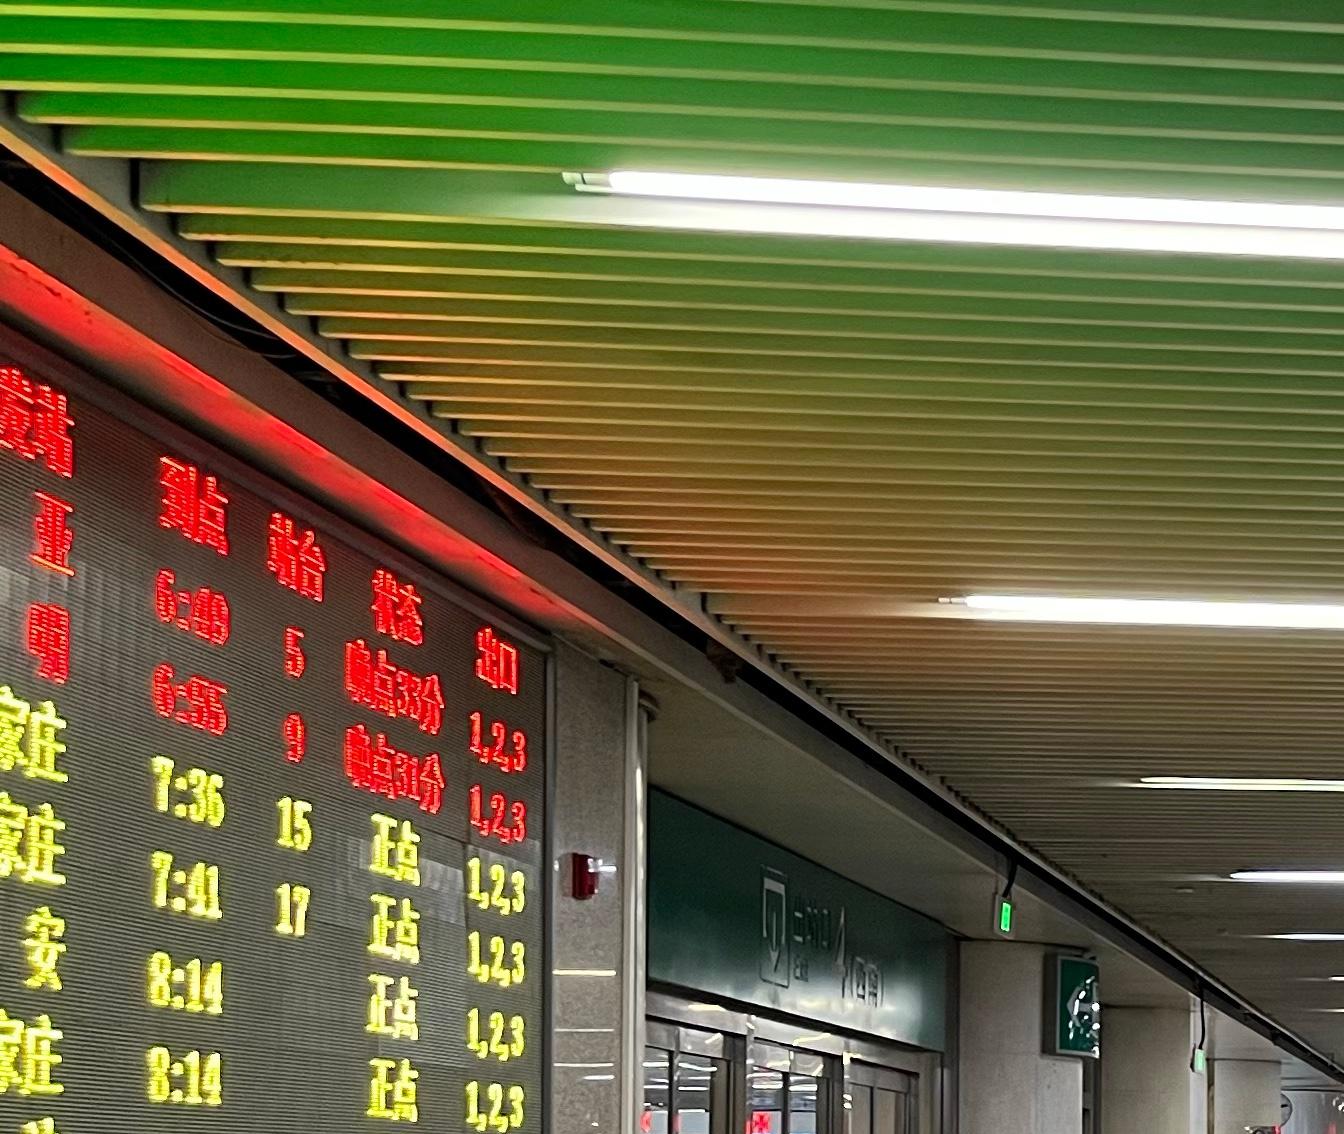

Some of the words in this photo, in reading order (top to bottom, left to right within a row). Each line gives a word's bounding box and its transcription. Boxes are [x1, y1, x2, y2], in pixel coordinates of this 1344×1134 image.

[160, 457, 228, 555] 到点
[267, 513, 325, 601] 站台
[372, 570, 422, 645] 状态
[476, 628, 517, 693] 出口
[285, 628, 304, 677] 5
[283, 715, 305, 762] 9
[151, 756, 224, 827] 7:36
[276, 796, 312, 851] 15
[368, 813, 420, 886] 正点
[274, 883, 310, 937] 17
[367, 894, 420, 965] 正点
[24, 906, 66, 991] 安
[145, 952, 223, 1015] 8:14
[365, 974, 418, 1040] 正点
[145, 1047, 222, 1106] 8:14
[364, 1058, 419, 1122] 正点
